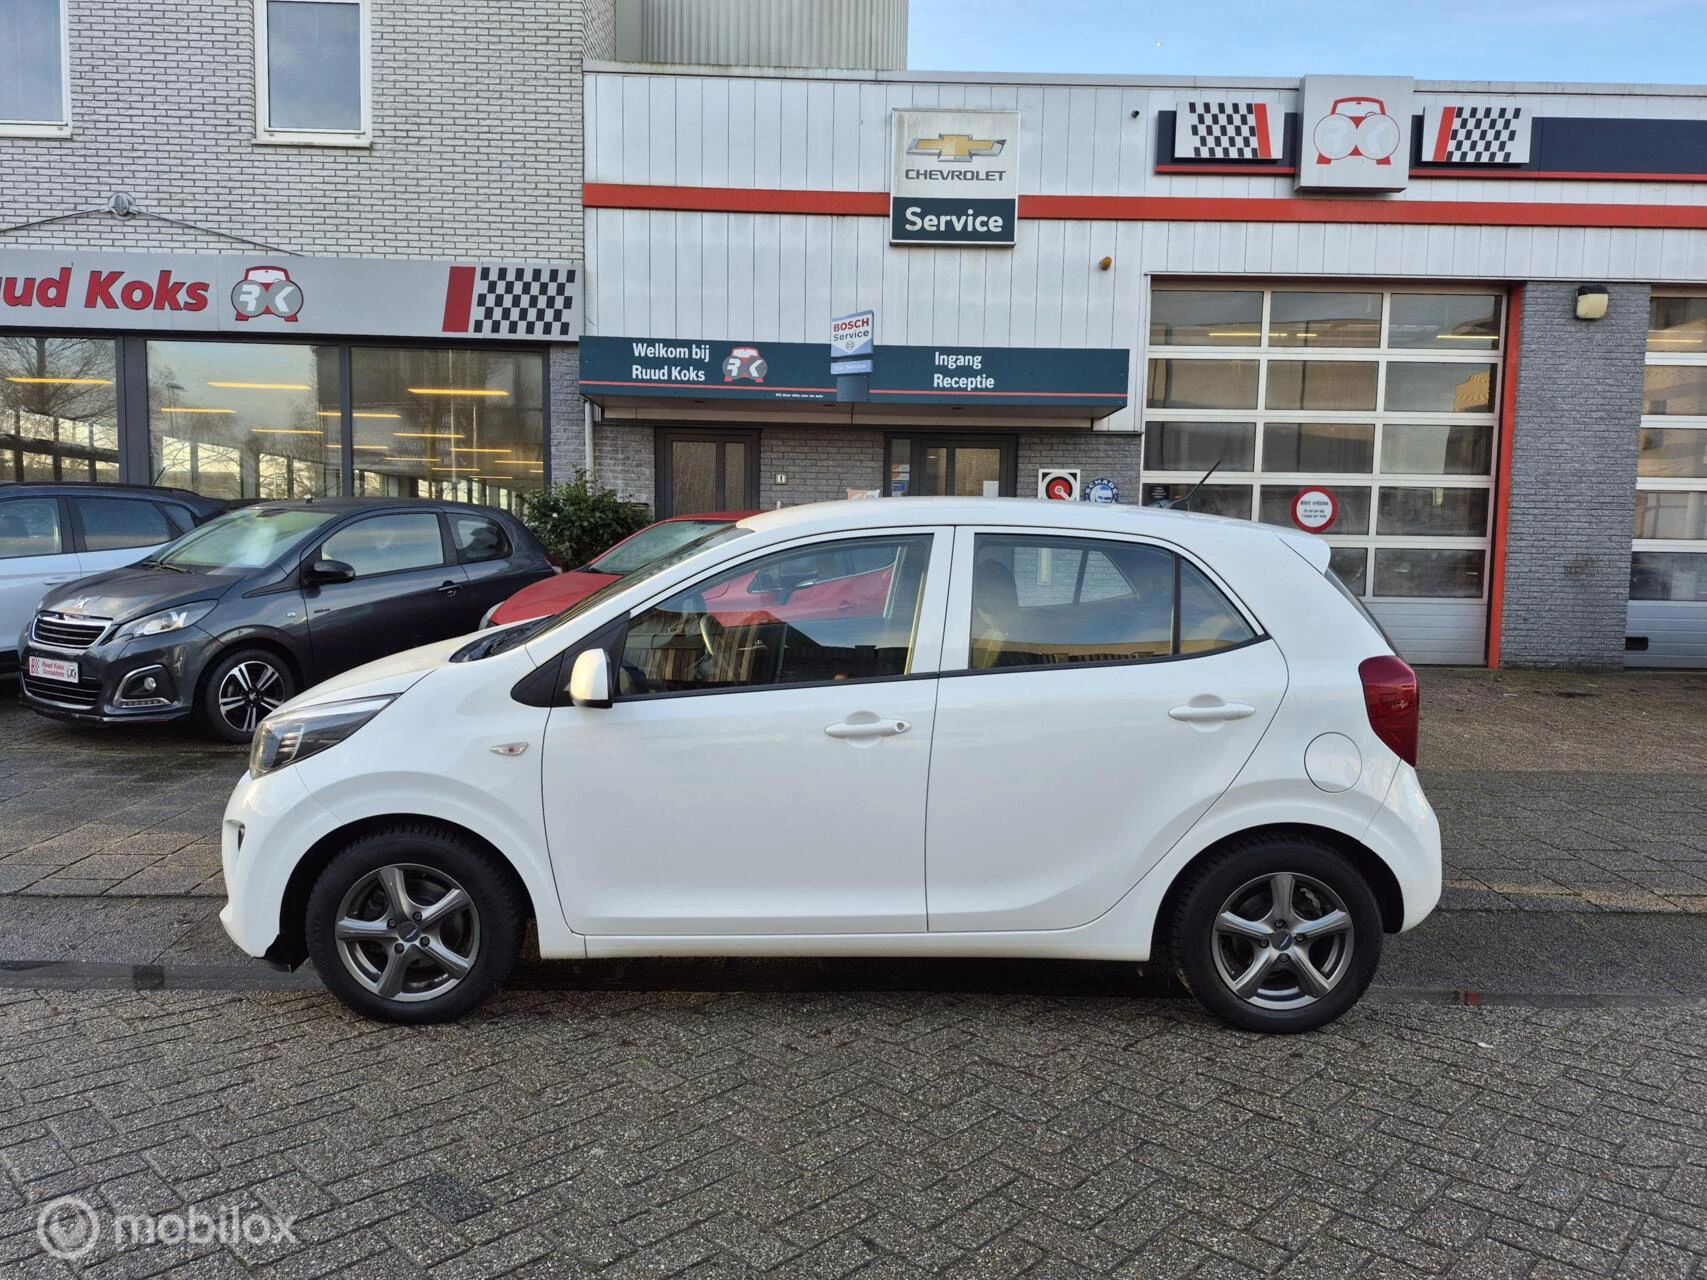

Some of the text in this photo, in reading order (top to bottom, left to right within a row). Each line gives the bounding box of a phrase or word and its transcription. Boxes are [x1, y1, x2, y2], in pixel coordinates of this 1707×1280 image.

[905, 169, 1006, 181] CHEVROLET
[905, 206, 1003, 232] Service
[0, 267, 209, 311] uud Koks
[833, 317, 870, 332] BOSCH
[833, 329, 870, 342] Service
[632, 342, 710, 362] Welkom bij
[935, 351, 982, 370] Ingang
[632, 364, 706, 382] Ruud Koks
[933, 373, 995, 391] Receptie
[1085, 479, 1118, 495] SCHADE
